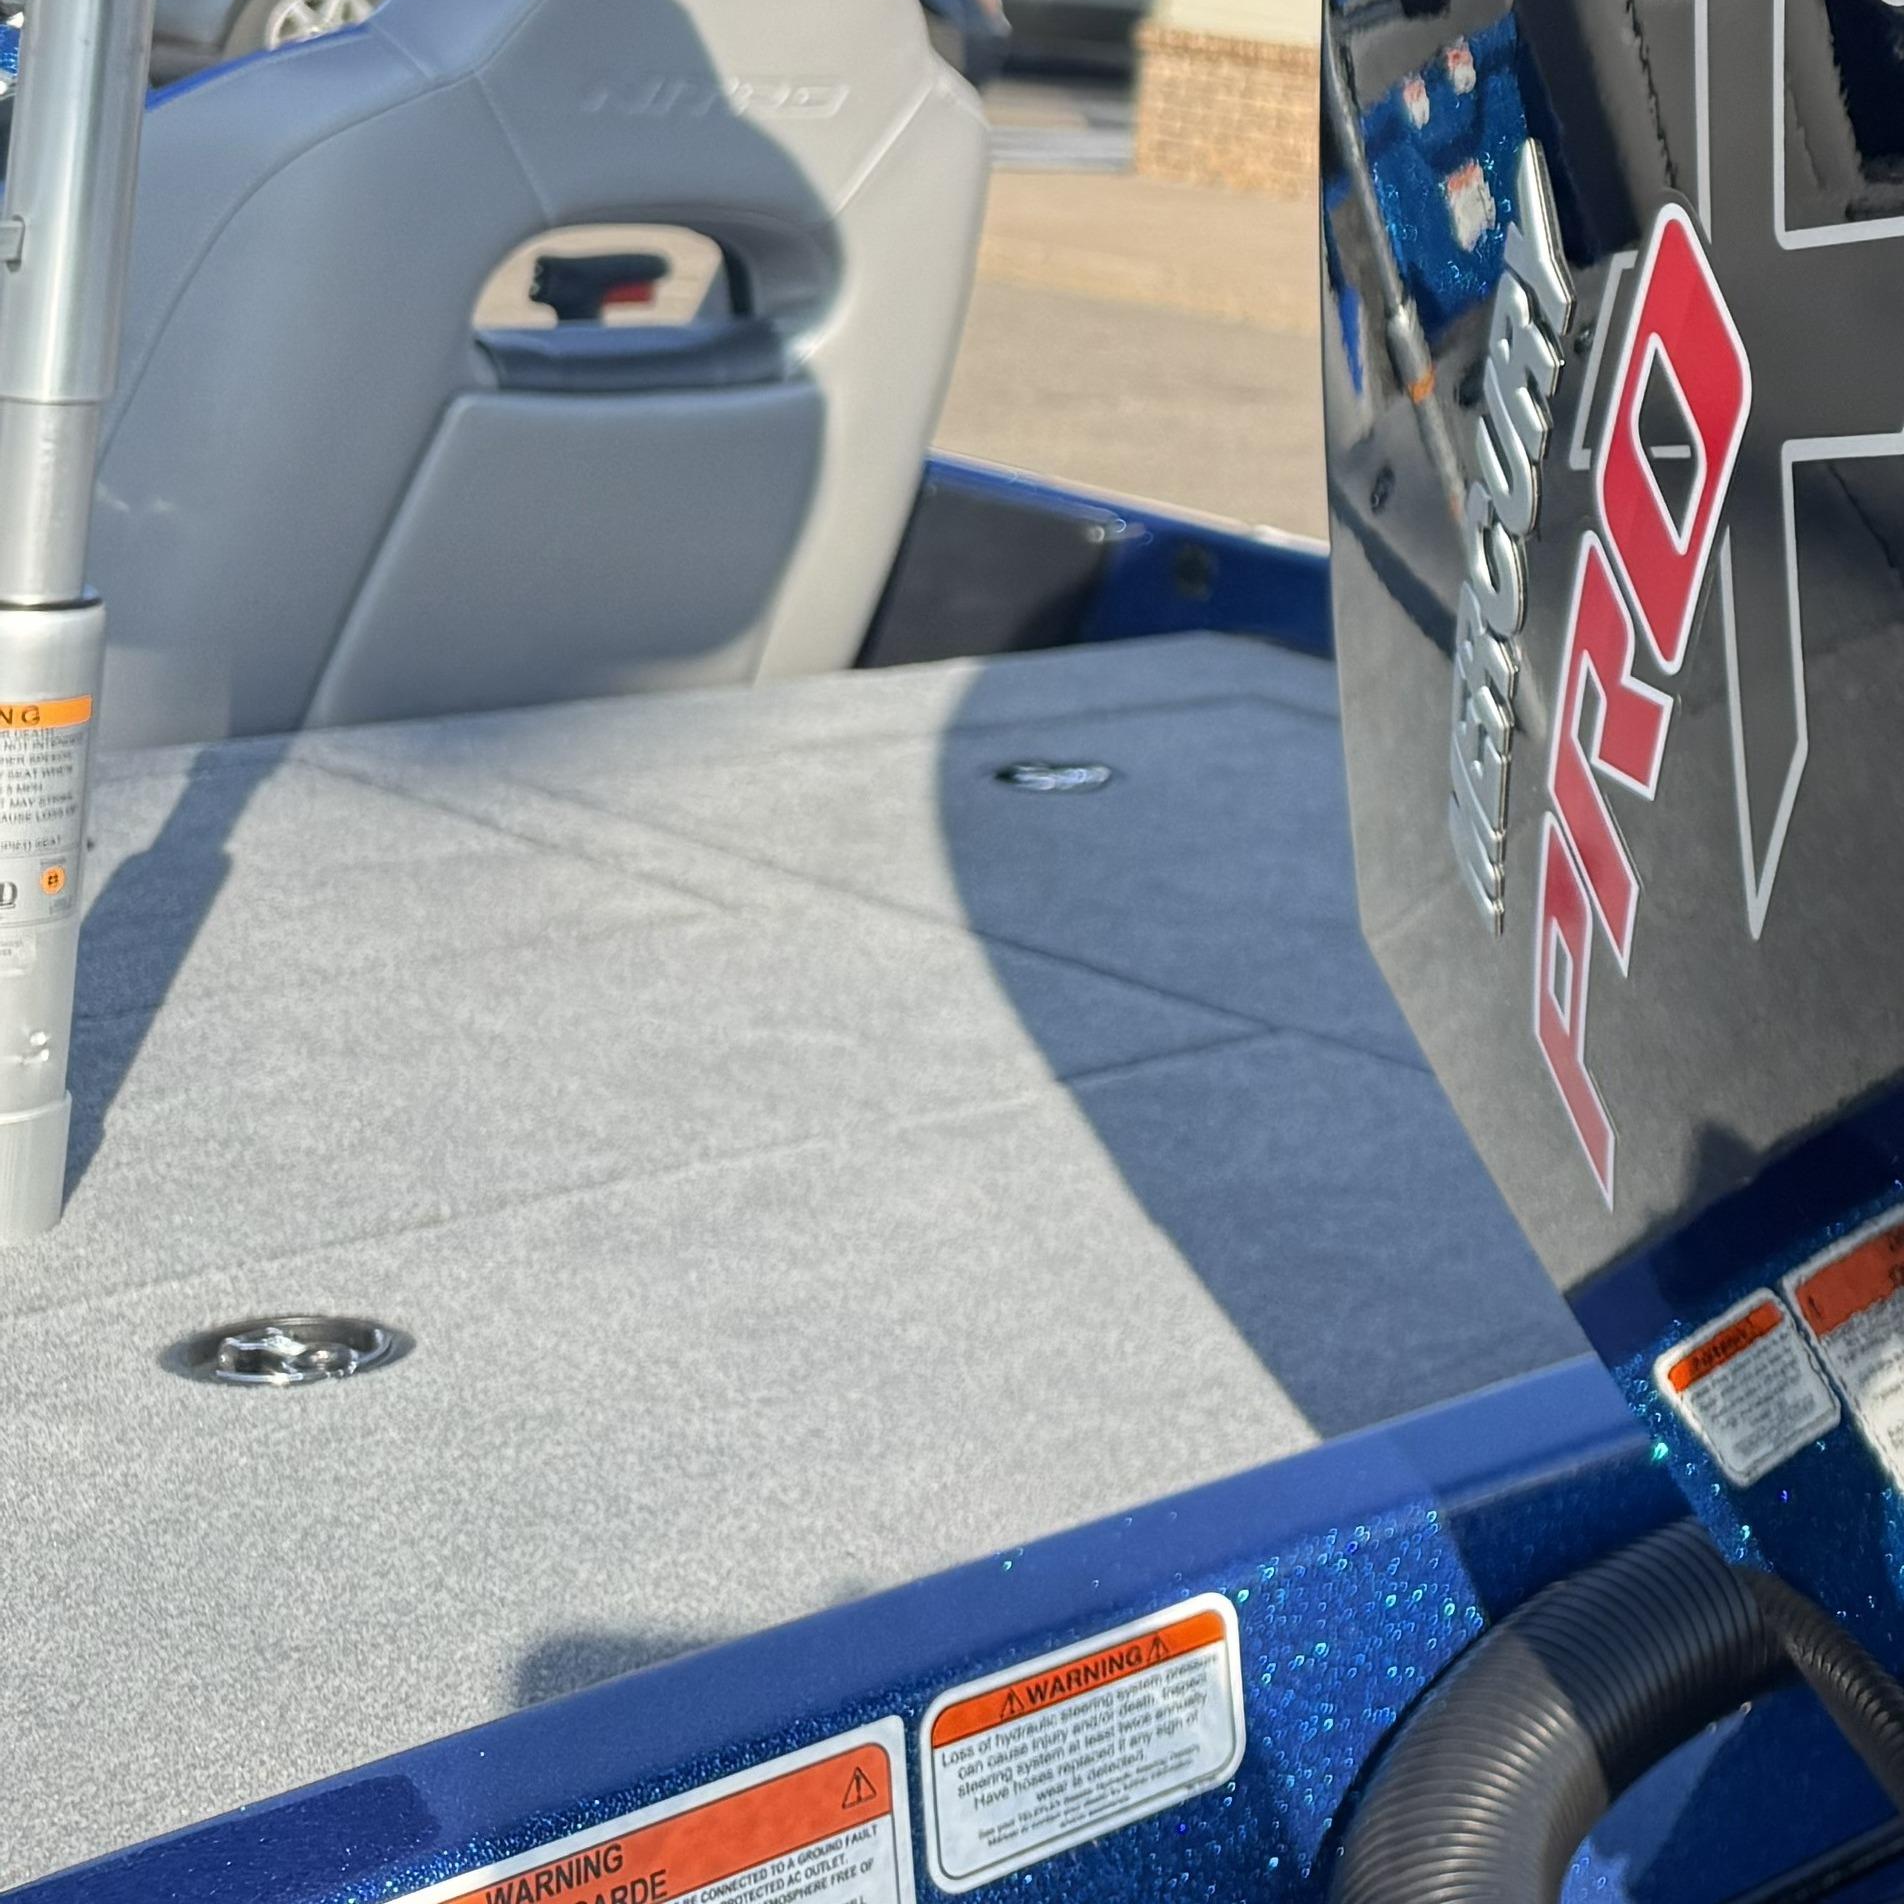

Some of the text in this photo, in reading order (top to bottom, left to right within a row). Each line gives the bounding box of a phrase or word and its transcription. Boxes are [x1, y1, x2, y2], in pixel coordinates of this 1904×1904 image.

[1448, 138, 1576, 936] MERCURY
[1534, 201, 1752, 1212] PRO
[1026, 1645, 1142, 1705] WARNING
[942, 1747, 975, 1768] Loss
[978, 1737, 992, 1754] of
[958, 1760, 984, 1781] can
[987, 1742, 1029, 1768] cause
[1017, 1746, 1065, 1776] system
[974, 1786, 1009, 1810] Have
[485, 1844, 623, 1904] WARNING
[700, 1868, 768, 1903] CONNECTED
[771, 1860, 785, 1876] TO
[787, 1857, 796, 1871] A
[797, 1837, 844, 1866] GROUND
[844, 1824, 878, 1848] FAULT
[787, 1870, 802, 1887] AC
[831, 1864, 857, 1887] FREE
[860, 1856, 874, 1874] OF
[575, 1869, 668, 1904] RDE
